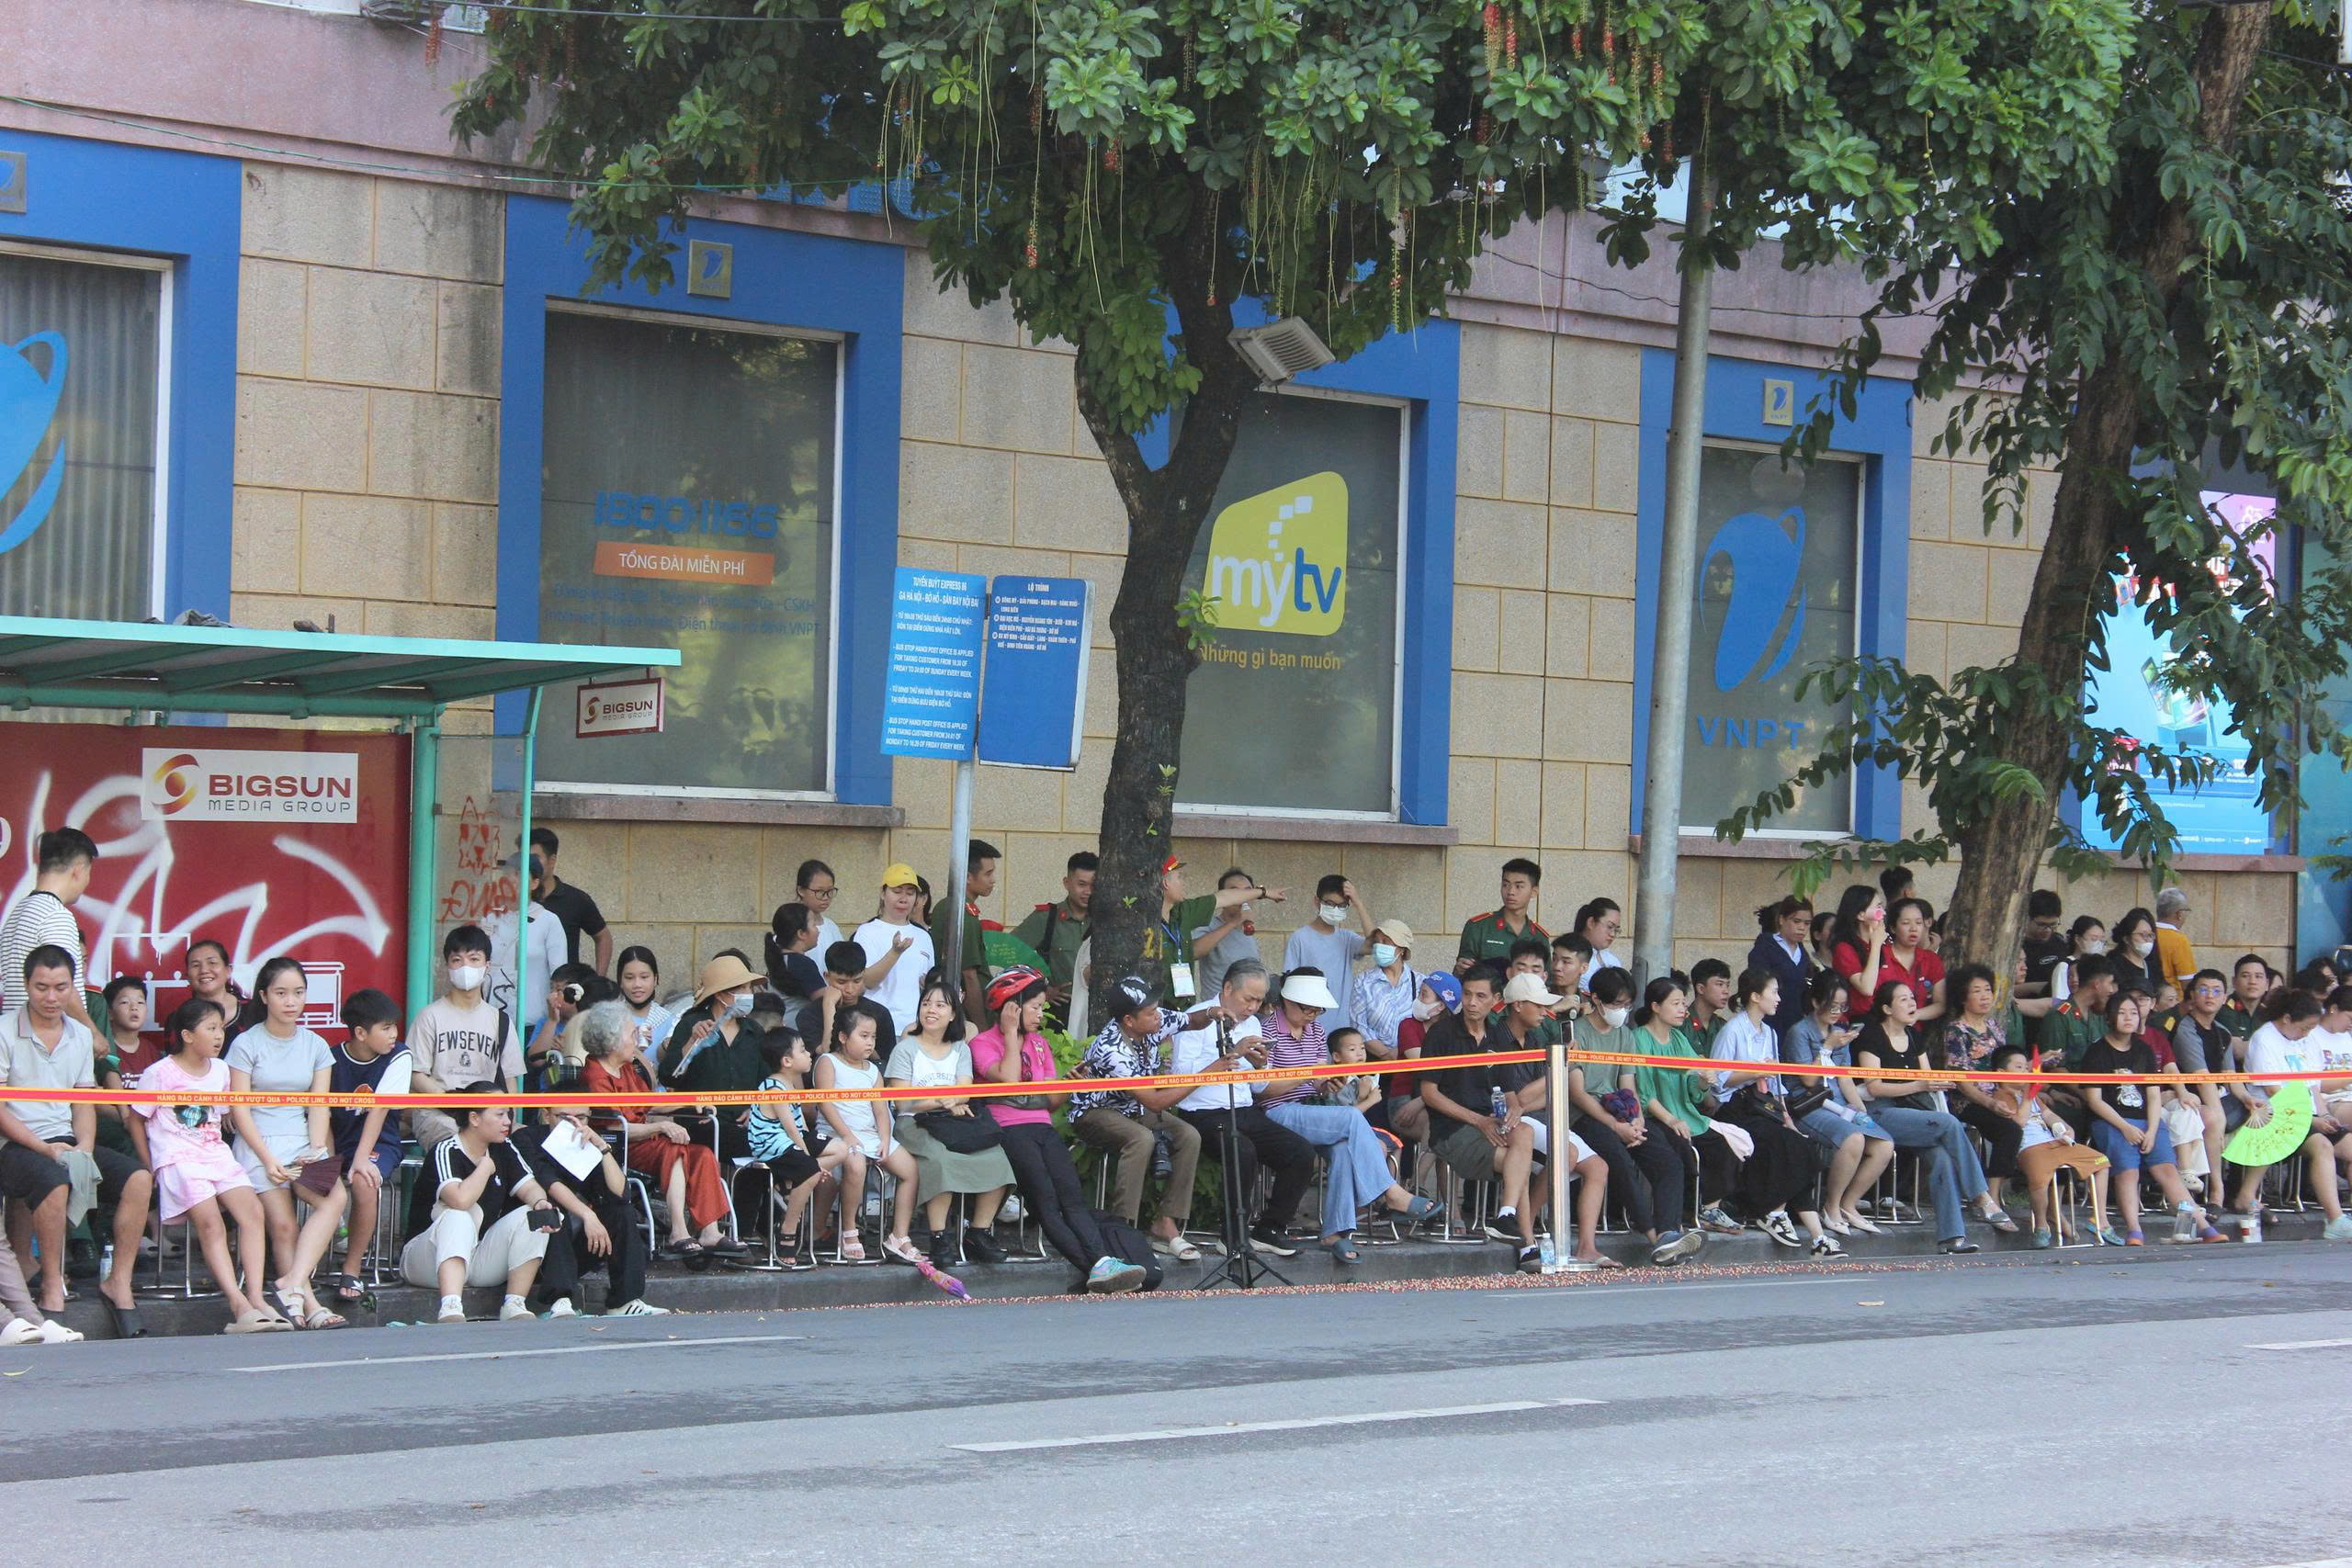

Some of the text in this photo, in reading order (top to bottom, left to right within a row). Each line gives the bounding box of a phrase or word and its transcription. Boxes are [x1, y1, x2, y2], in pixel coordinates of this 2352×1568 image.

[618, 549, 745, 575] TỔNG ĐÀI MIỄN PHÍ
[940, 579, 961, 590] EXPRESS
[1027, 582, 1034, 592] LỘ
[952, 595, 962, 605] BAY
[1252, 648, 1265, 669] gì
[1270, 649, 1296, 671] bạn
[1301, 650, 1341, 670] muốn
[603, 700, 653, 714] BIGSUN
[603, 713, 625, 721] MEDIA
[1696, 713, 1805, 750] VNPT
[209, 774, 351, 798] BIGSUN
[209, 799, 351, 813] MEDIA GROUP
[157, 1093, 176, 1101] HÀNG
[178, 1093, 191, 1101] RÀO
[194, 1093, 212, 1101] CẢNH
[230, 1094, 243, 1102] CẤM
[245, 1095, 265, 1103] VƯỢT
